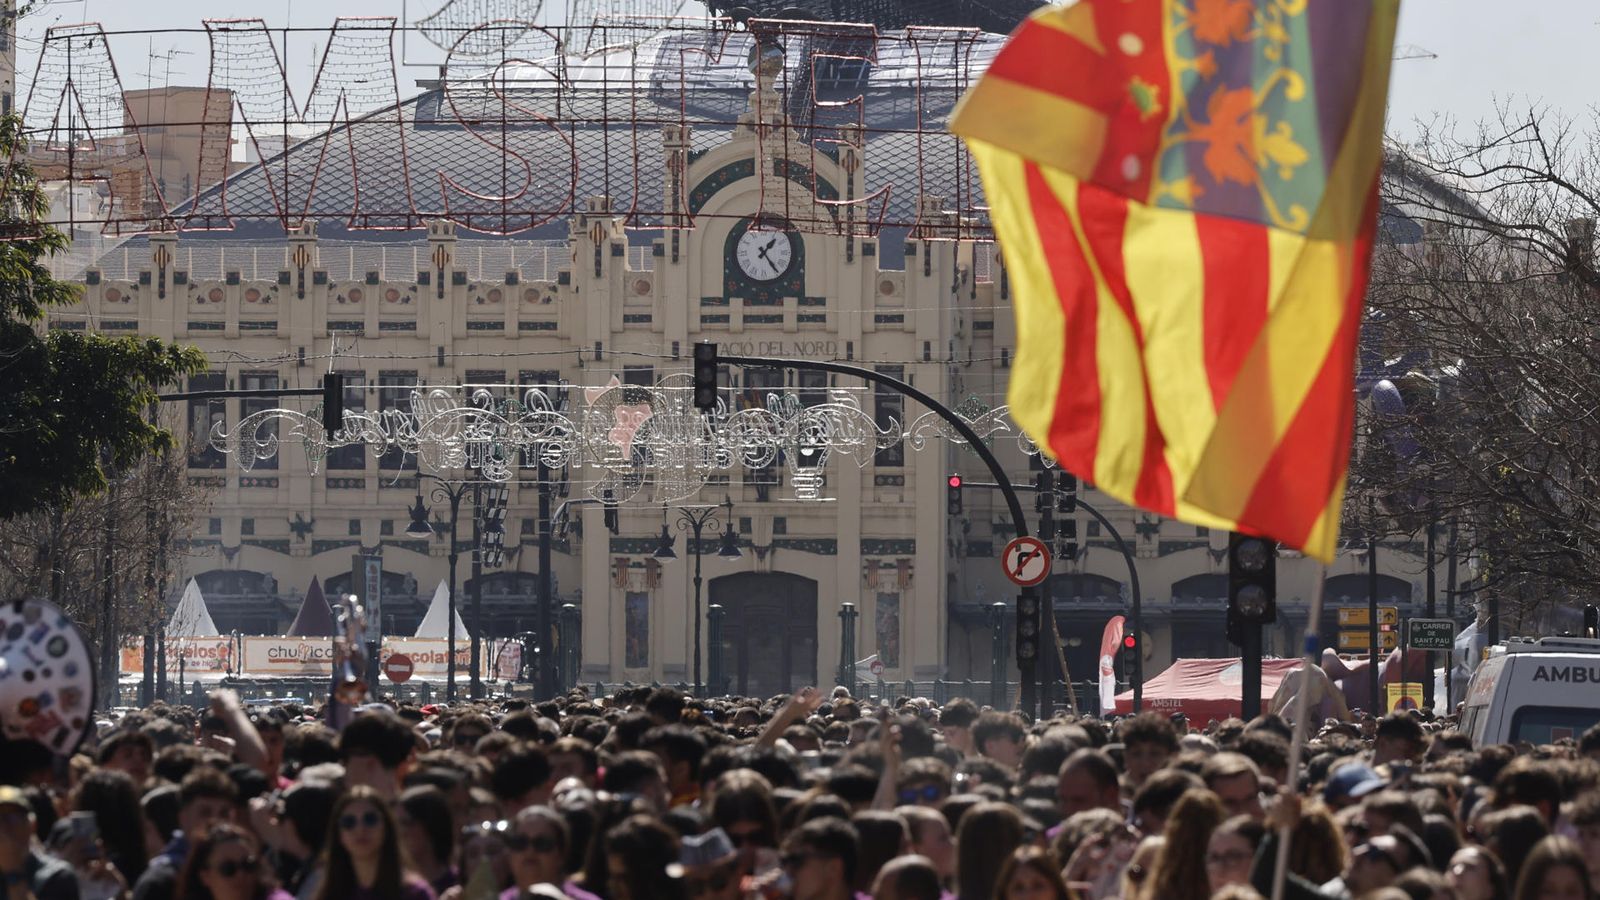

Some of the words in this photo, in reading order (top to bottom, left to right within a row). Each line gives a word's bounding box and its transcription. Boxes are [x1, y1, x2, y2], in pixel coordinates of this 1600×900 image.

[716, 338, 754, 356] ACIÓ
[759, 341, 790, 356] DEL
[794, 341, 838, 356] NORD
[1532, 665, 1600, 683] AMBU
[1151, 698, 1184, 708] AMSTEL
